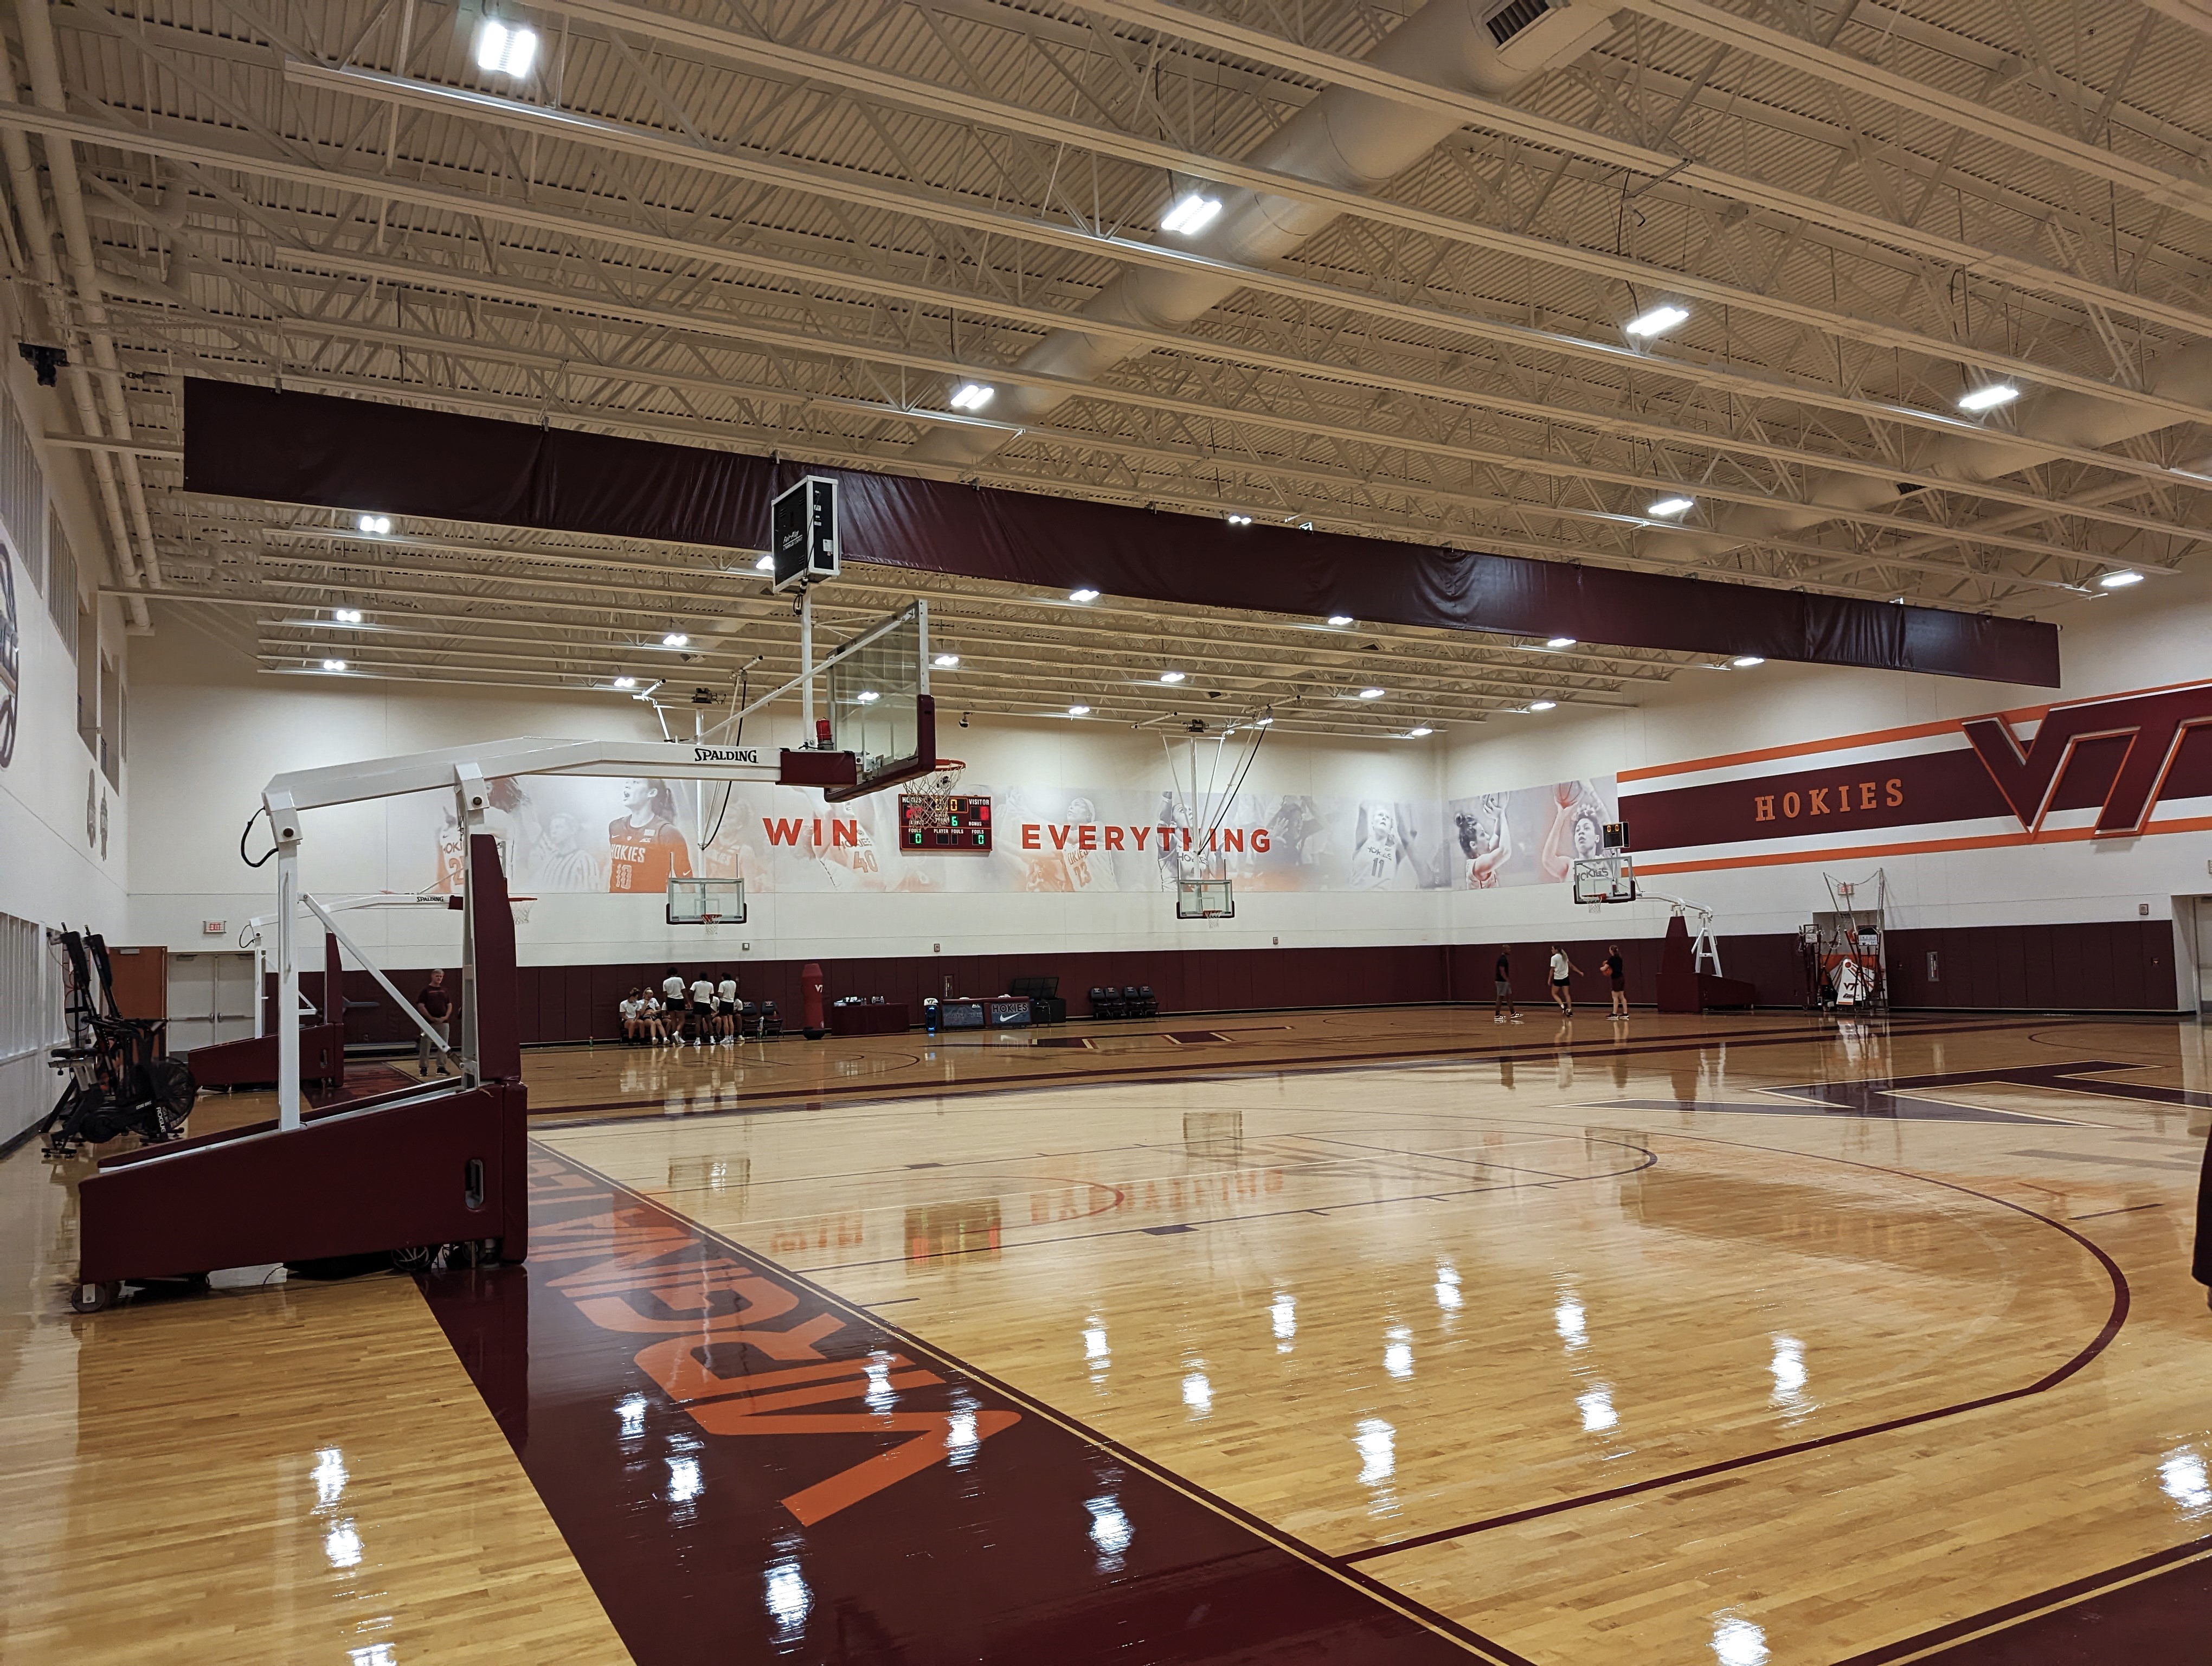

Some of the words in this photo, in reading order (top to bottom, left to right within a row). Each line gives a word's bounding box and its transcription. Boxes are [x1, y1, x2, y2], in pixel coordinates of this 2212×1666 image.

[695, 748, 757, 764] SPALDING
[1961, 682, 2212, 841] VT
[1754, 779, 1904, 822] HOKIES
[762, 818, 857, 846] WIN
[1022, 824, 1270, 853] EVERYTHING
[915, 834, 922, 844] 0
[978, 835, 984, 844] 0
[853, 850, 878, 873] 40
[1371, 857, 1384, 878] 11
[616, 864, 632, 889] 10
[1843, 982, 1860, 991] VT
[992, 1003, 1028, 1013] HOKIES
[156, 1106, 166, 1133] ROGUE
